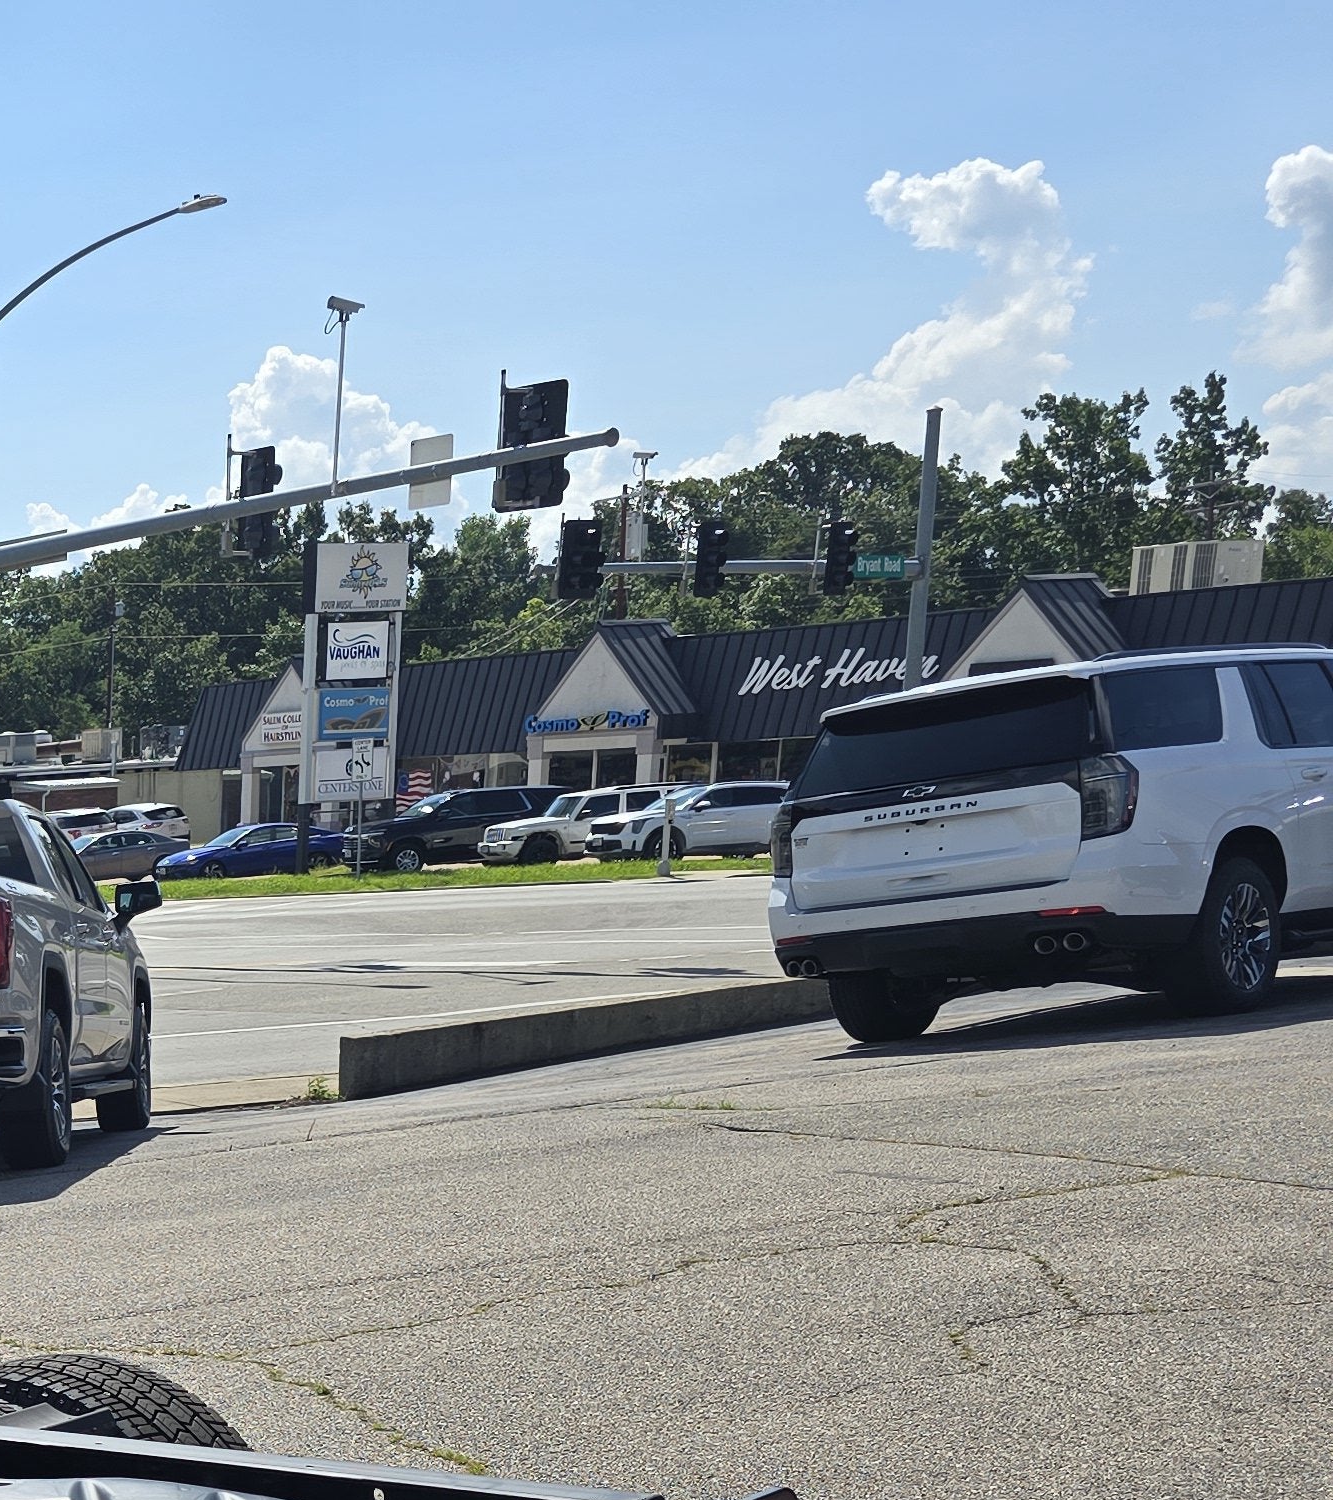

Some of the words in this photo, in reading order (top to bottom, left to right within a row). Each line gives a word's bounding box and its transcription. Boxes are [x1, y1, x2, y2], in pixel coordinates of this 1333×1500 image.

[857, 556, 882, 576] Bryant
[883, 556, 901, 572] Road
[321, 600, 335, 610] YOUR
[379, 599, 401, 608] STATION
[329, 645, 380, 660] VAUGHAN
[737, 654, 822, 696] West
[324, 696, 354, 707] Cosmo
[524, 714, 582, 734] Cosmo
[607, 708, 651, 728] Prof
[318, 780, 384, 794] CENTERSONE
[863, 800, 978, 823] SUBURBAN
